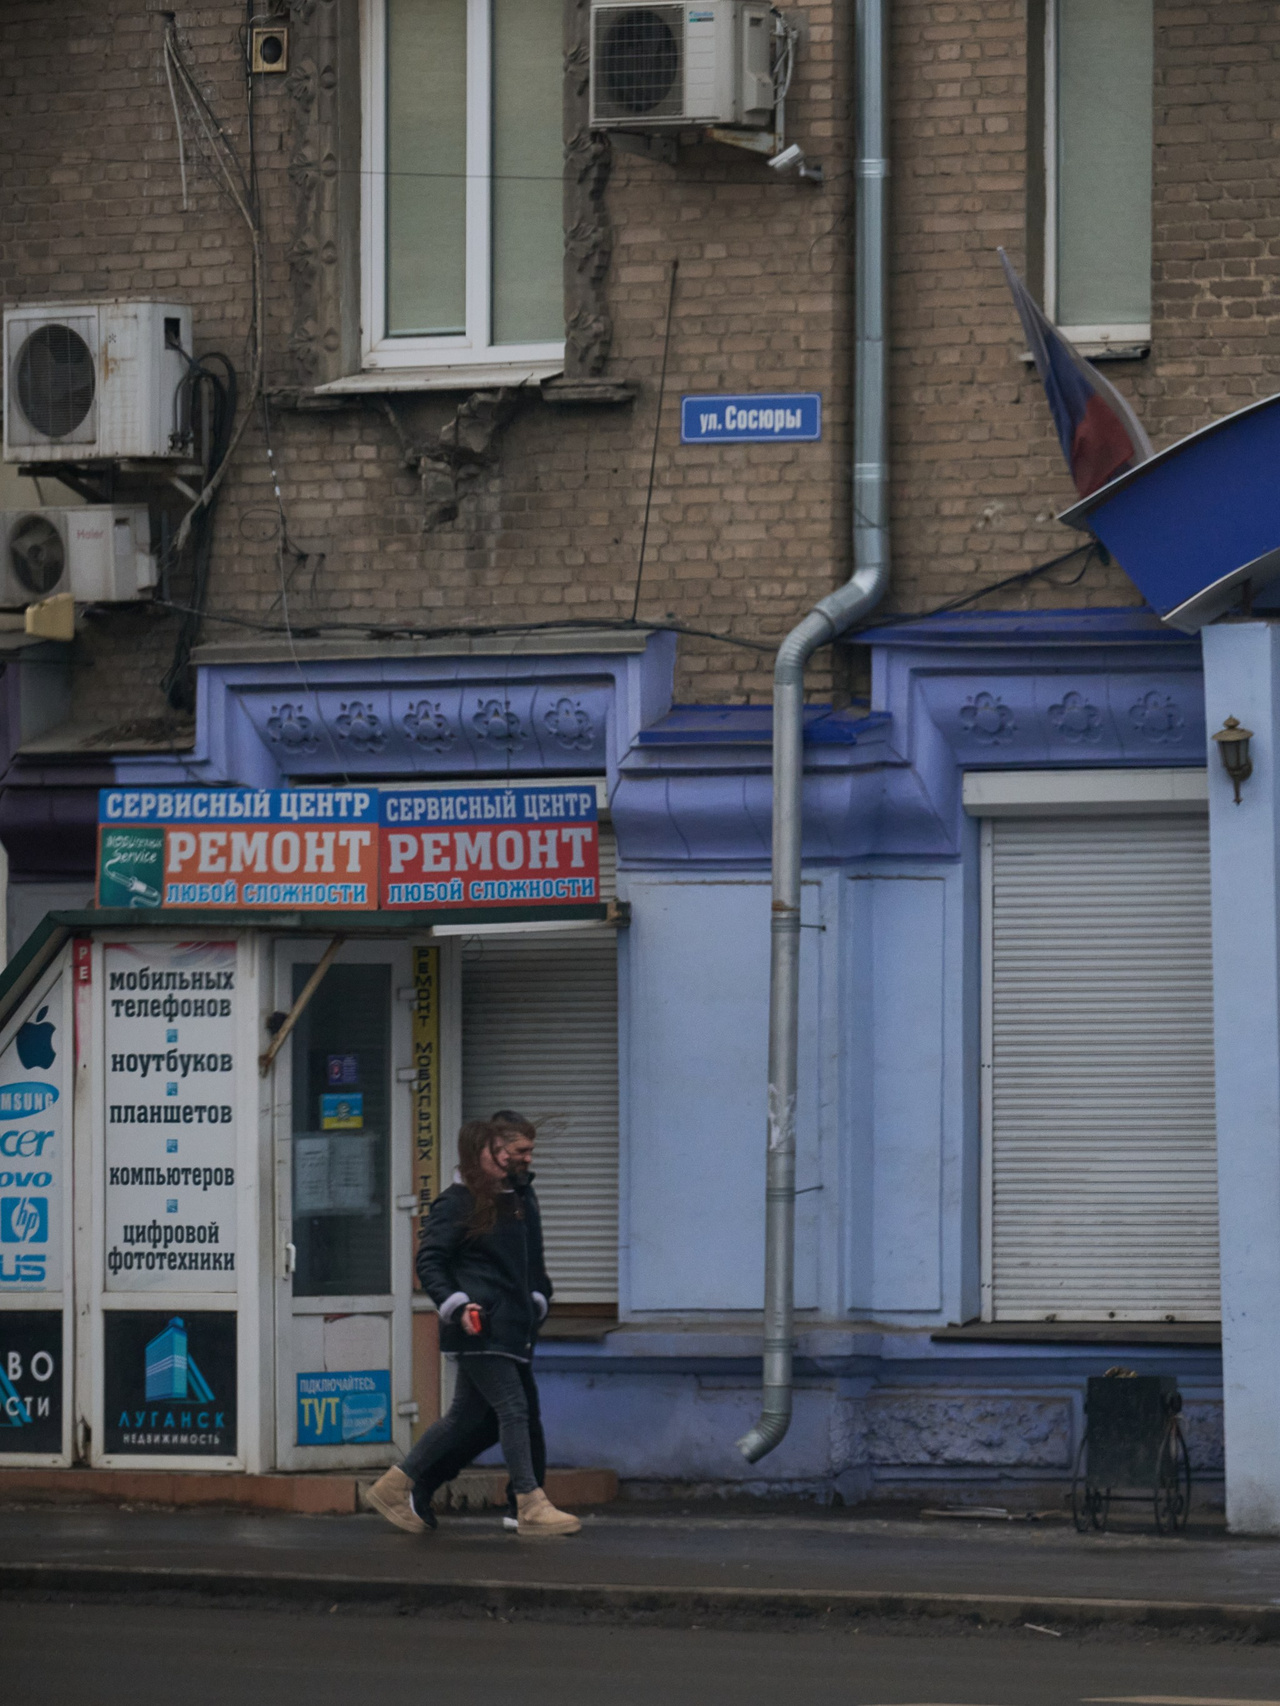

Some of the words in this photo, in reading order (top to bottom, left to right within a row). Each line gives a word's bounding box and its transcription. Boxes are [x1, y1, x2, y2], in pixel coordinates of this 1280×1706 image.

[700, 413, 723, 434] ул.
[725, 405, 803, 433] Сосюры
[106, 788, 272, 819] СЕРВИСНЫЙ
[279, 792, 371, 821] ЦЕНТР
[386, 790, 517, 822] СЕРВИСНЫЙ
[523, 793, 592, 820] ЦЕНТР
[166, 830, 372, 874] РЕМОНТ
[387, 827, 593, 874] РЕМОНТ
[166, 879, 238, 905] ЛЮБОЙ
[242, 883, 368, 905] СЛОЖНОСТИ
[387, 877, 464, 904] ЛЮБОЙ
[469, 876, 596, 901] СЛОЖНОСТИ
[109, 966, 235, 991] мобильных
[111, 993, 232, 1023] телефонов
[111, 1048, 233, 1078] ноутбуков
[109, 1104, 233, 1124] планшетов
[109, 1166, 235, 1191] компьютеров
[123, 1219, 220, 1249] цифровой
[107, 1246, 235, 1276] фототехники
[0, 1396, 50, 1417] СТИ
[118, 1411, 224, 1428] ЛУГАНСК
[123, 1432, 221, 1445] НЕДВИЖИМОСТЬ
